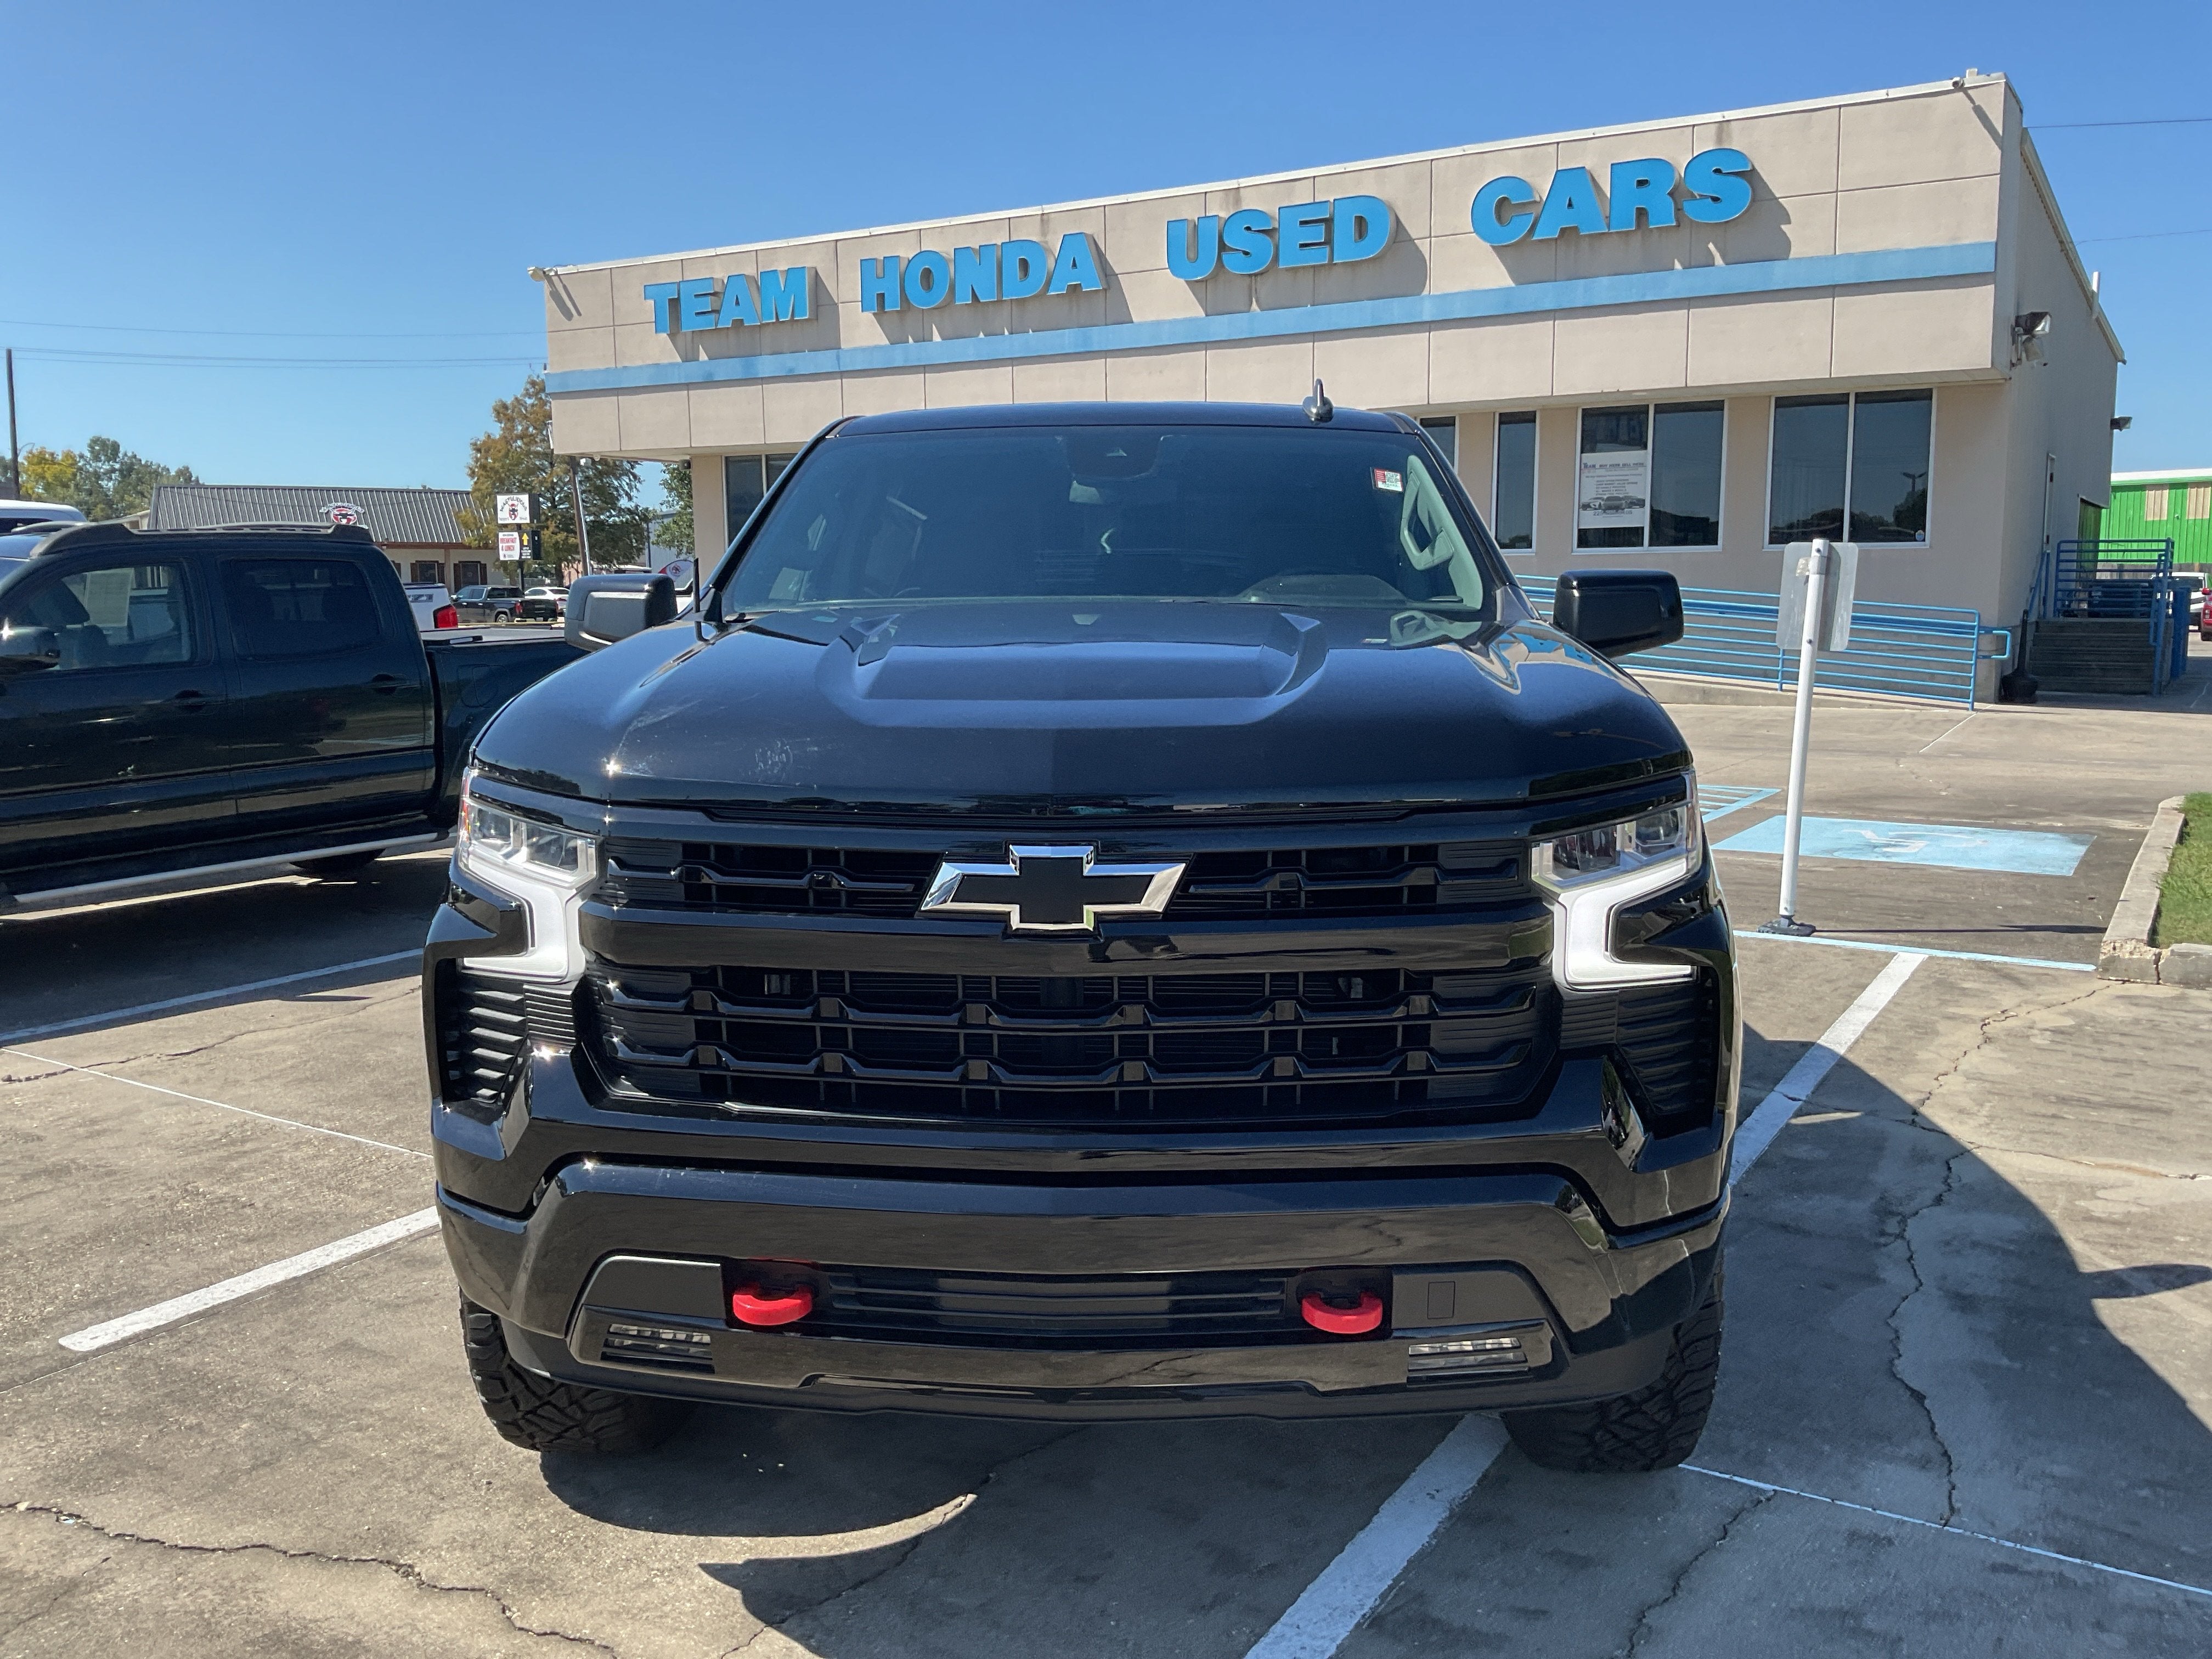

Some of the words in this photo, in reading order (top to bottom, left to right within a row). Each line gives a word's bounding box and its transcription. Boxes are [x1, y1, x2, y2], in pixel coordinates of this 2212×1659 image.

[644, 266, 812, 334] TEAM
[860, 232, 1104, 313] HONDA
[1166, 195, 1395, 281] USED
[1471, 148, 1753, 246] CARS
